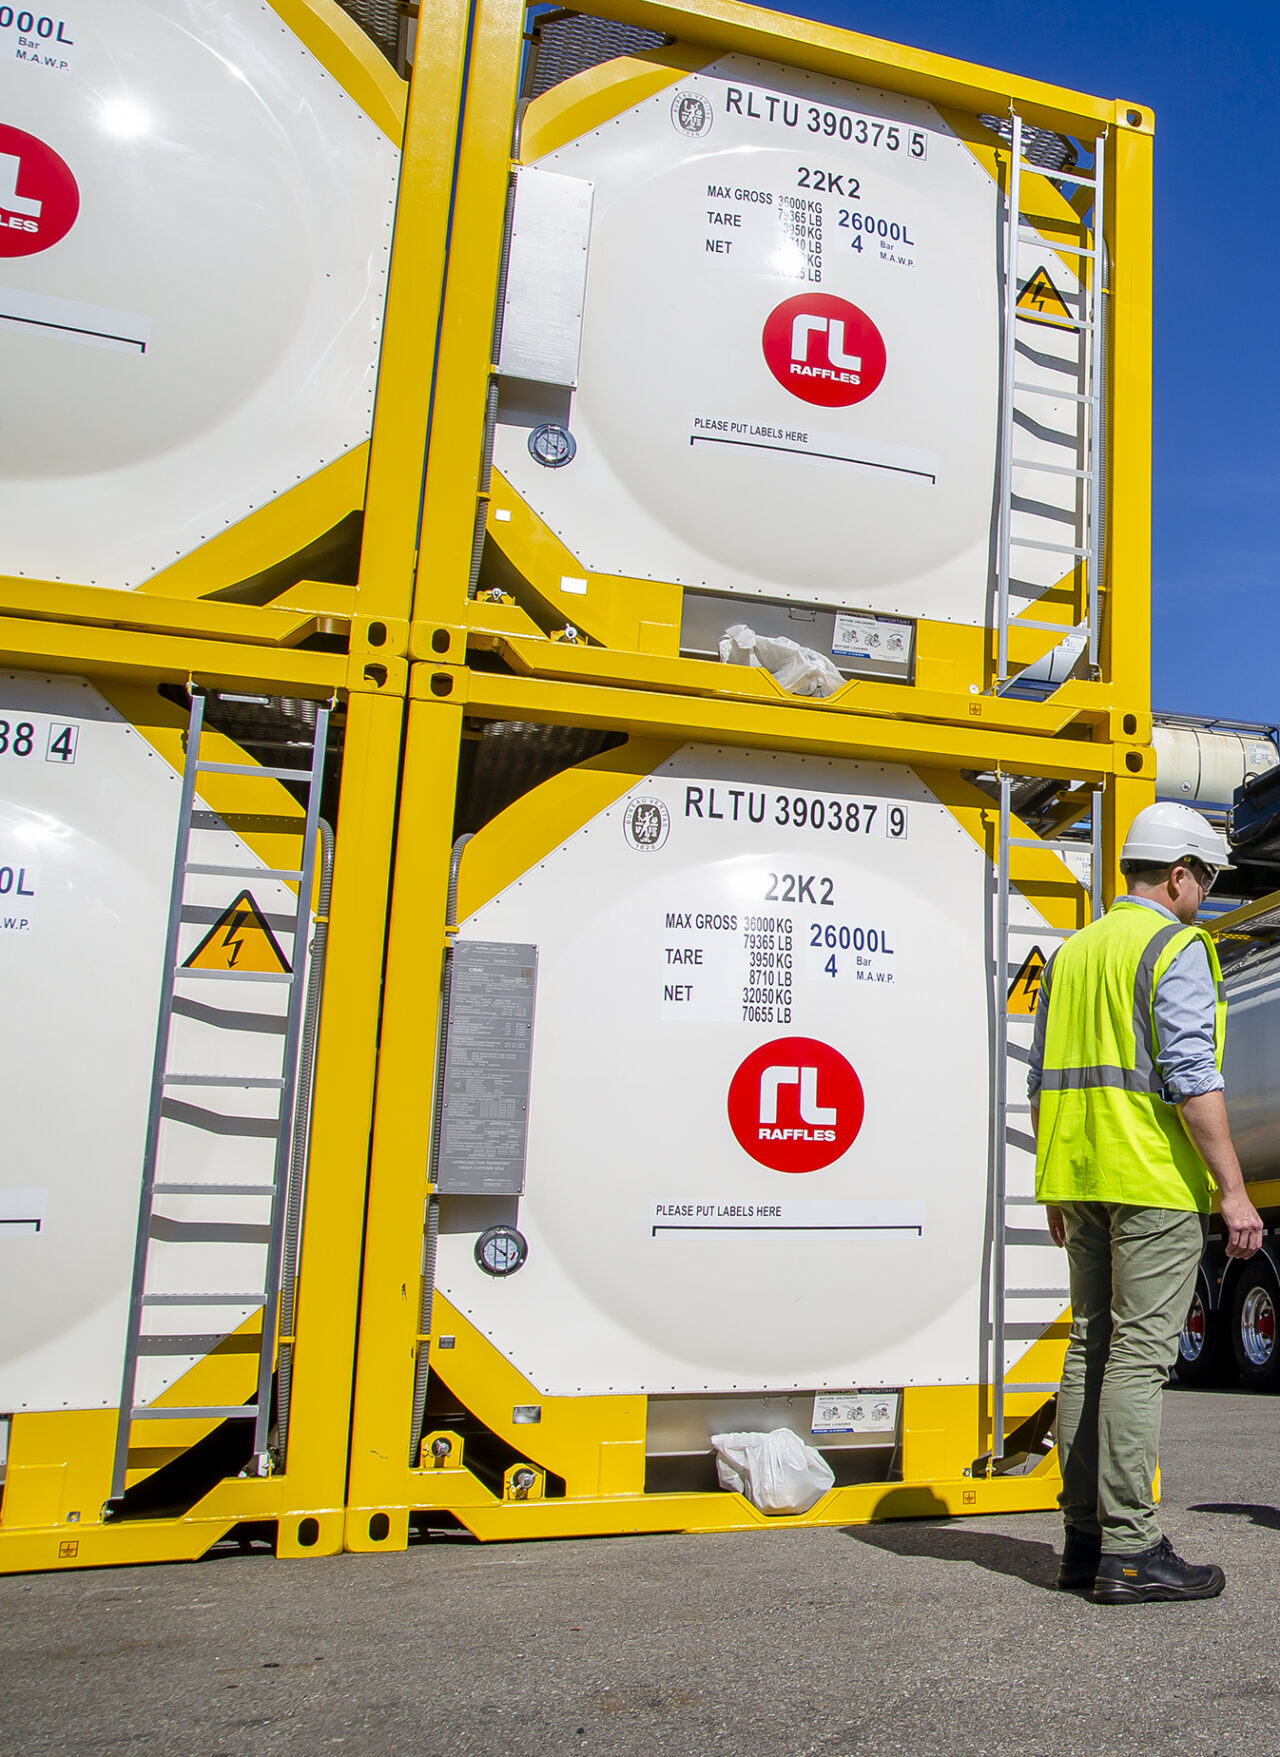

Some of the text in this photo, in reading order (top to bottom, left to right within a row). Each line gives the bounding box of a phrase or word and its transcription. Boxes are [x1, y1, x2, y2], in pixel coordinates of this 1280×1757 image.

[18, 36, 40, 49] Bar
[16, 49, 70, 71] M.A.W.P.
[726, 87, 926, 159] RLTU 390375 5
[797, 166, 862, 201] 22K2
[707, 185, 823, 214] MAX GROSS 36000 KG
[706, 211, 742, 227] TARE
[808, 228, 823, 241] KG
[809, 215, 823, 227] LB
[838, 209, 915, 246] 26000L
[705, 239, 733, 254] NET
[807, 255, 822, 269] KG
[808, 241, 823, 254] LB
[850, 234, 894, 254] 4 Bar
[880, 251, 915, 269] M.A.W.P.
[808, 270, 822, 283] LB
[789, 363, 861, 386] RAFFLES
[694, 417, 809, 444] PLEASE PUT LABELS HERE
[49, 725, 75, 762] 4
[685, 786, 906, 838] RLTU 390387 9
[764, 872, 835, 906] 22K2
[665, 913, 793, 933] MAX GROSS 36000 KG
[743, 934, 793, 951] 79365 LB
[810, 923, 894, 954] 26000L
[665, 949, 792, 968] TARE 3950 KG
[824, 954, 872, 978] 4 Bar
[749, 969, 792, 987] 8710 LB
[856, 970, 895, 984] M.A.W.P.
[664, 985, 792, 1005] NET 32050 KG
[742, 1005, 792, 1023] 70655 LB
[758, 1128, 836, 1142] RAFFLES
[656, 1204, 782, 1218] PLEASE PUT LABELS HERE
